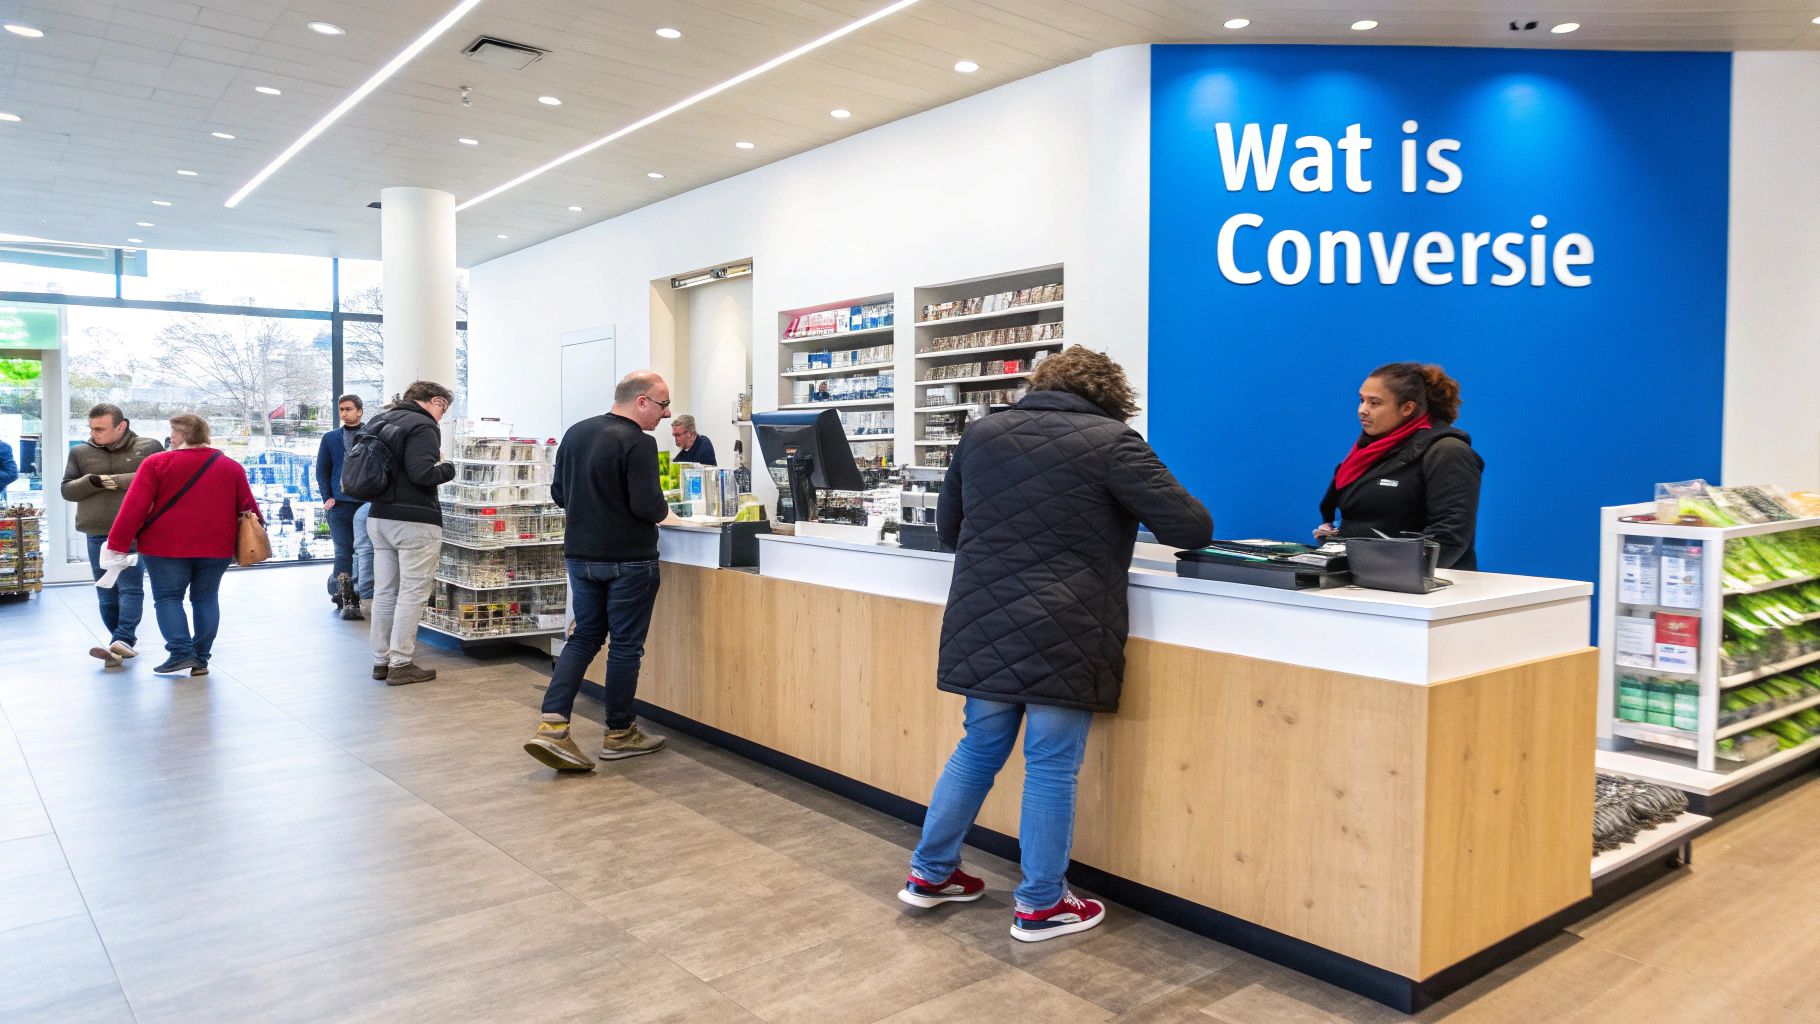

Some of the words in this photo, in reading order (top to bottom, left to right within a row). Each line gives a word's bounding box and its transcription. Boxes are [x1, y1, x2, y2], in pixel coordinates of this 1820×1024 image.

[1215, 122, 1372, 193] Wat
[1401, 120, 1463, 194] is
[1217, 213, 1595, 287] Conversie
